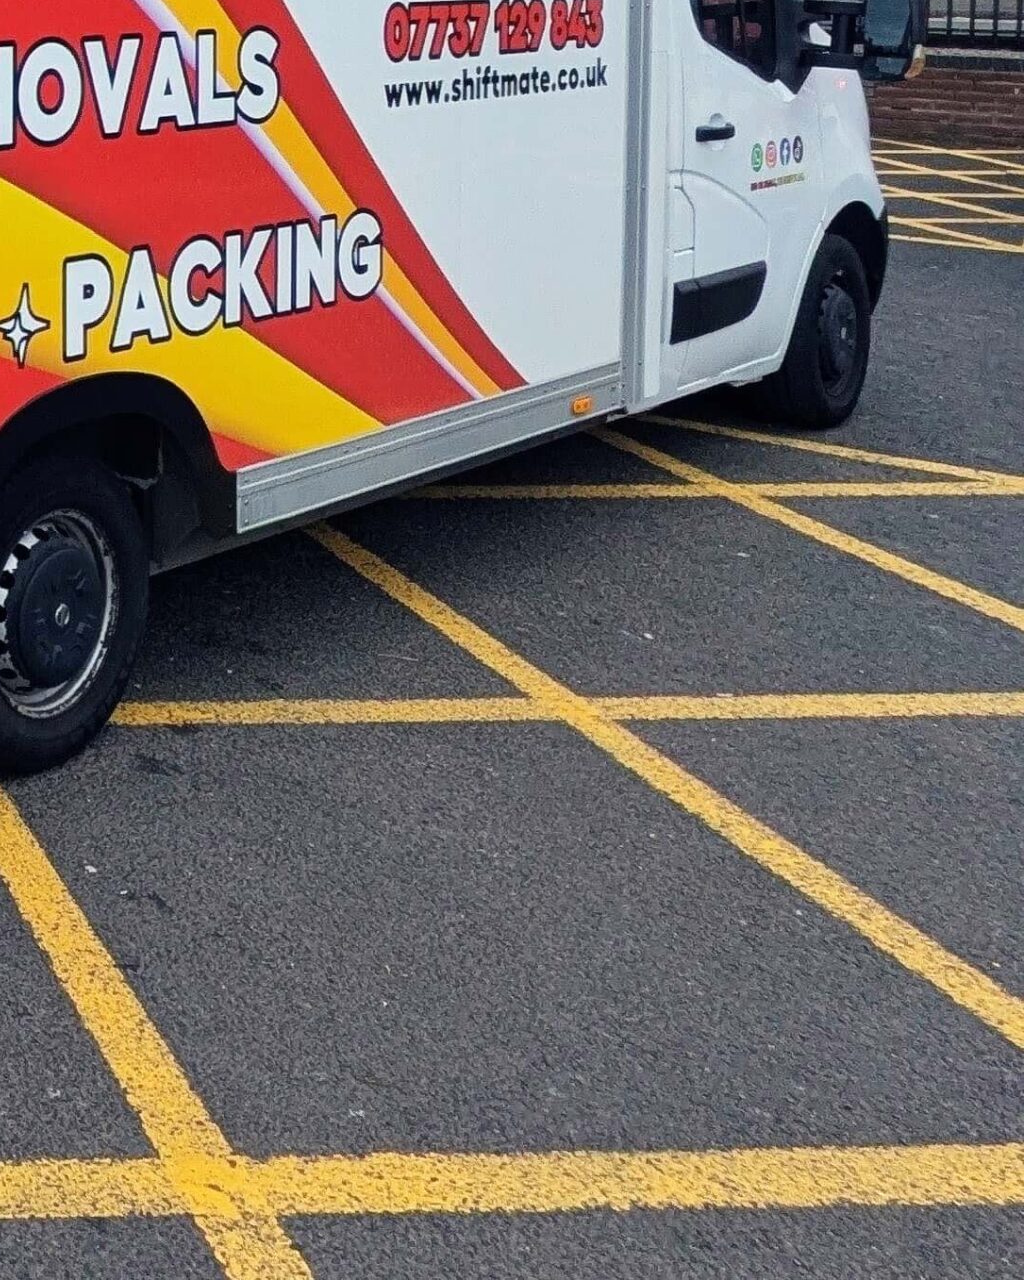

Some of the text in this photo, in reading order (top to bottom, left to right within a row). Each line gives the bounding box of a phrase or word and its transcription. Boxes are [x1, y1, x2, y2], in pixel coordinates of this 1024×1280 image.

[384, 0, 491, 63] 07737
[384, 57, 608, 108] www.shiftmate.co.uk
[62, 208, 383, 362] PACKING
